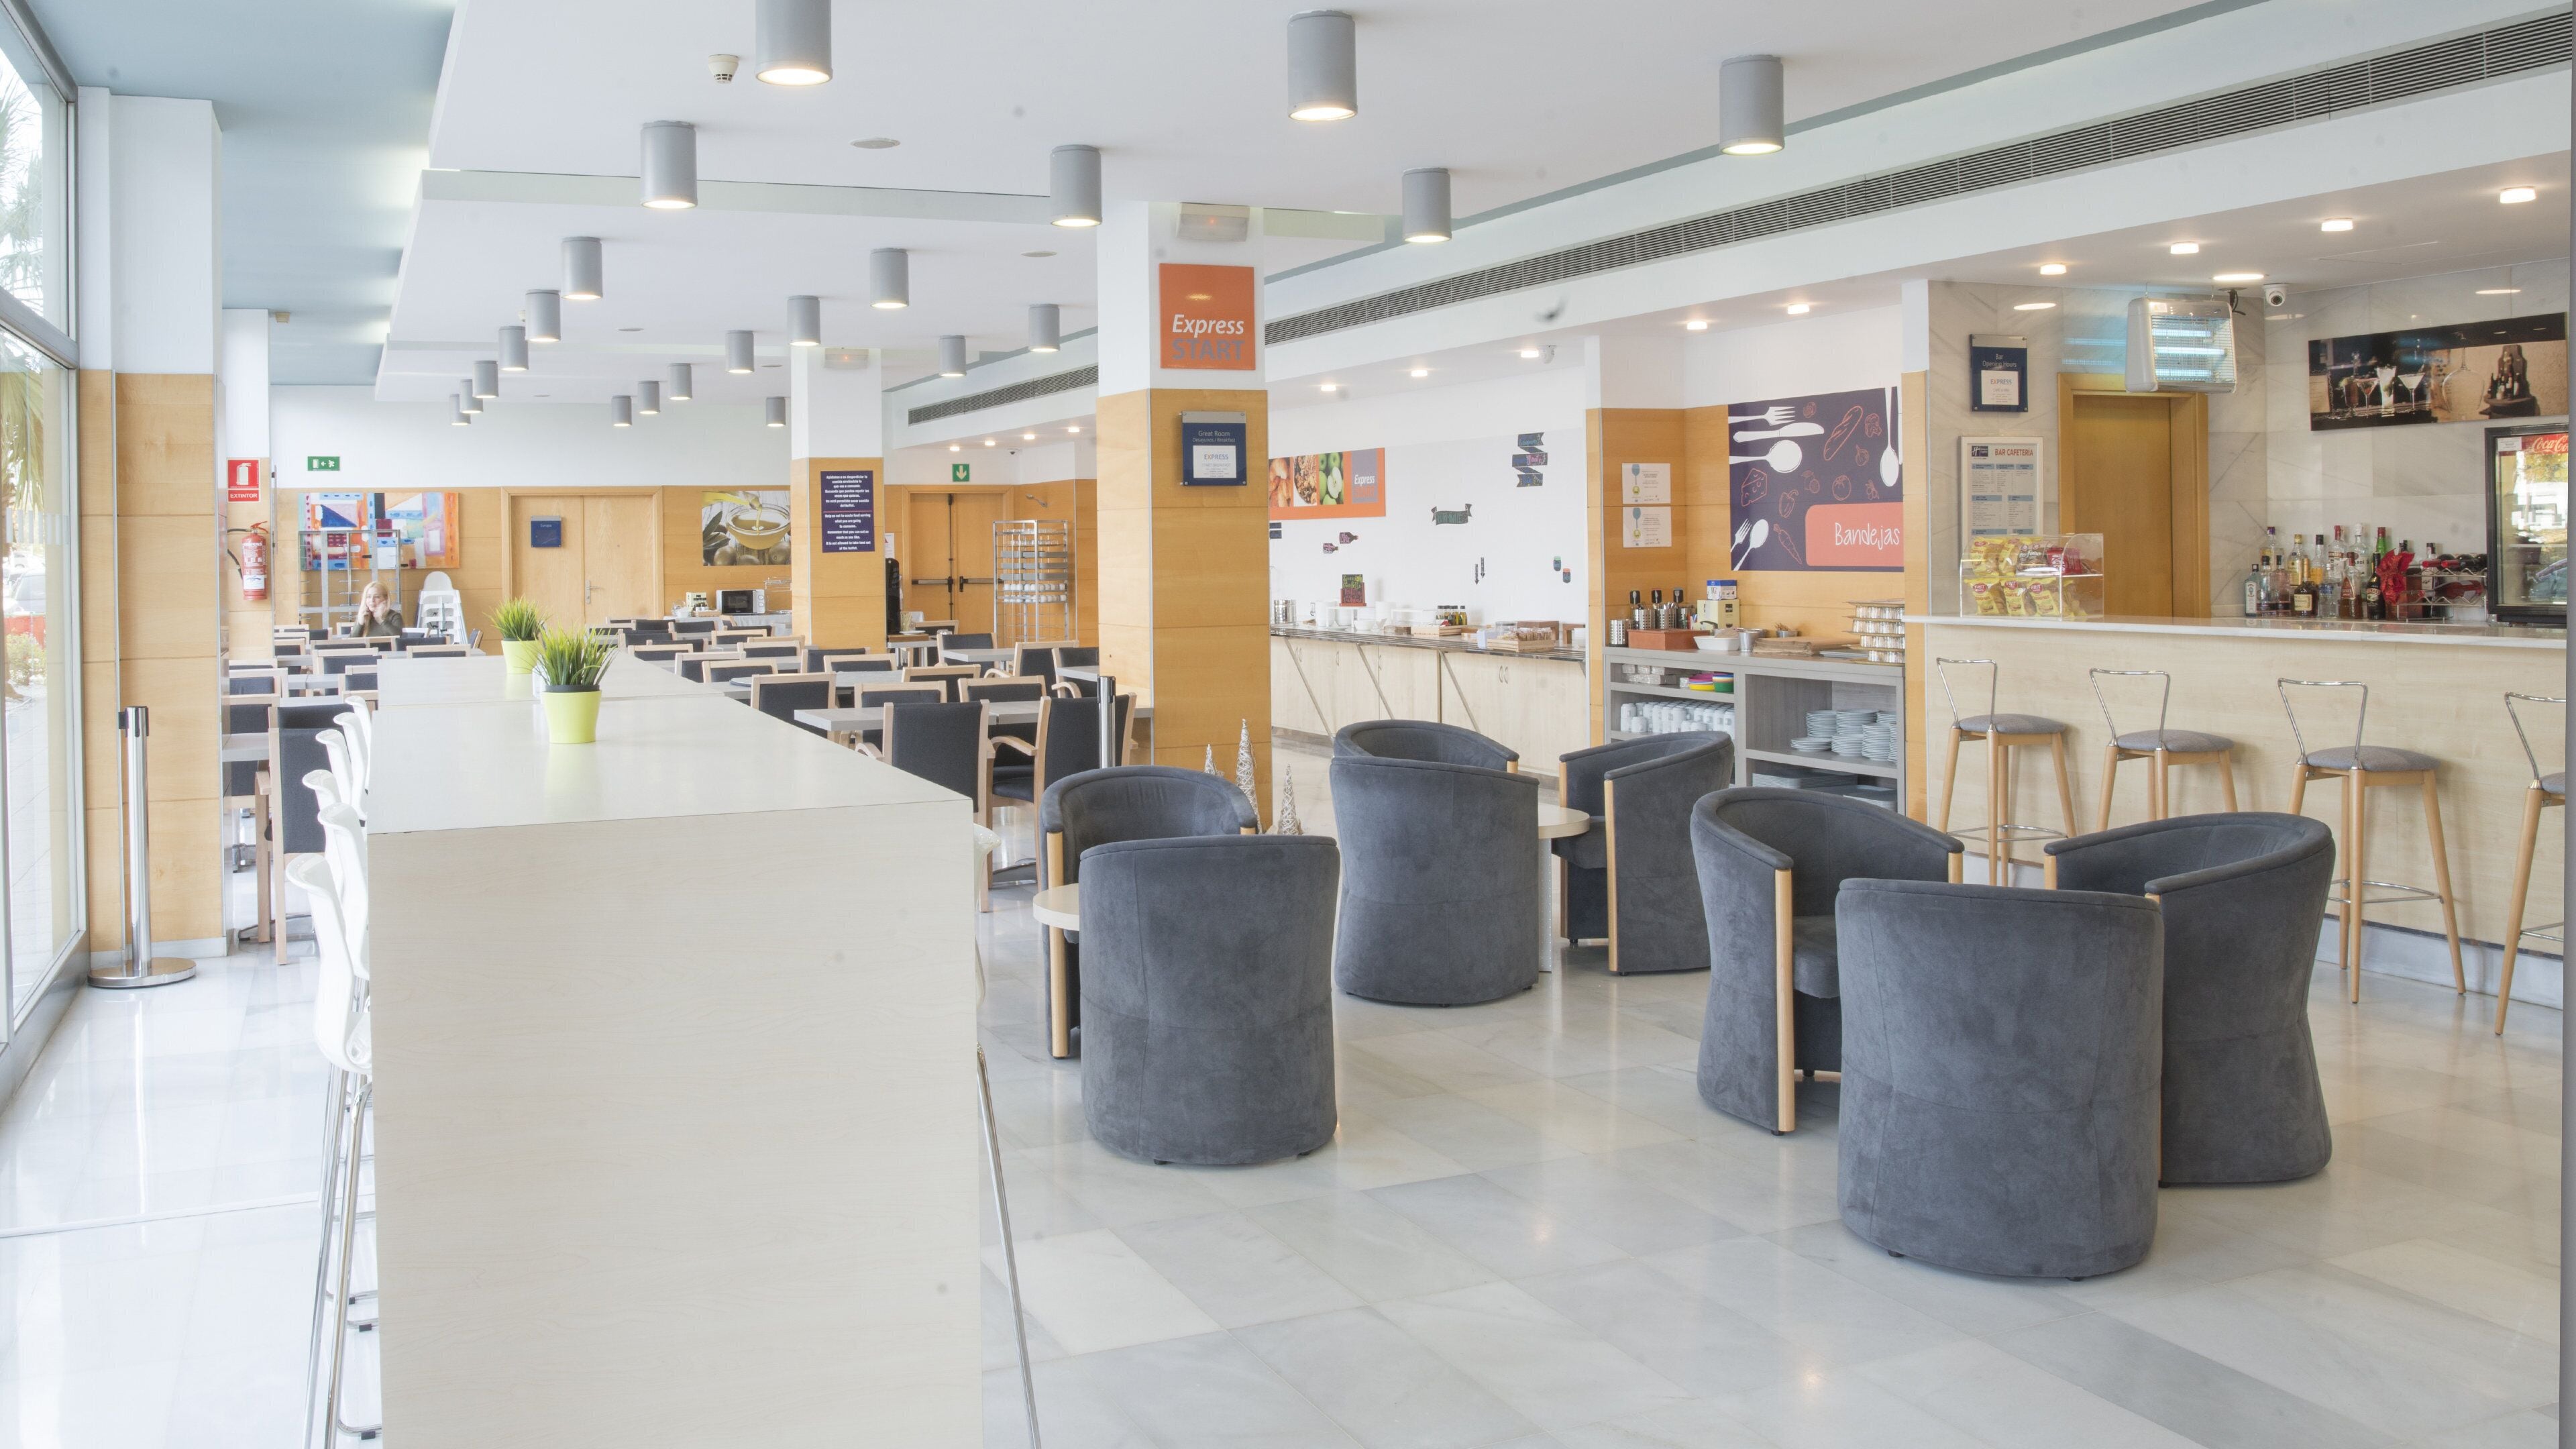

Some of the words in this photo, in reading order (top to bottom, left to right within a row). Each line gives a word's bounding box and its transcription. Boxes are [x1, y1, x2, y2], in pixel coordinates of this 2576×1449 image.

[1172, 313, 1244, 338] Express
[1171, 338, 1245, 360] START
[1995, 448, 2006, 456] BAR
[1354, 474, 1375, 487] Express
[1835, 522, 1900, 550] Bandejas
